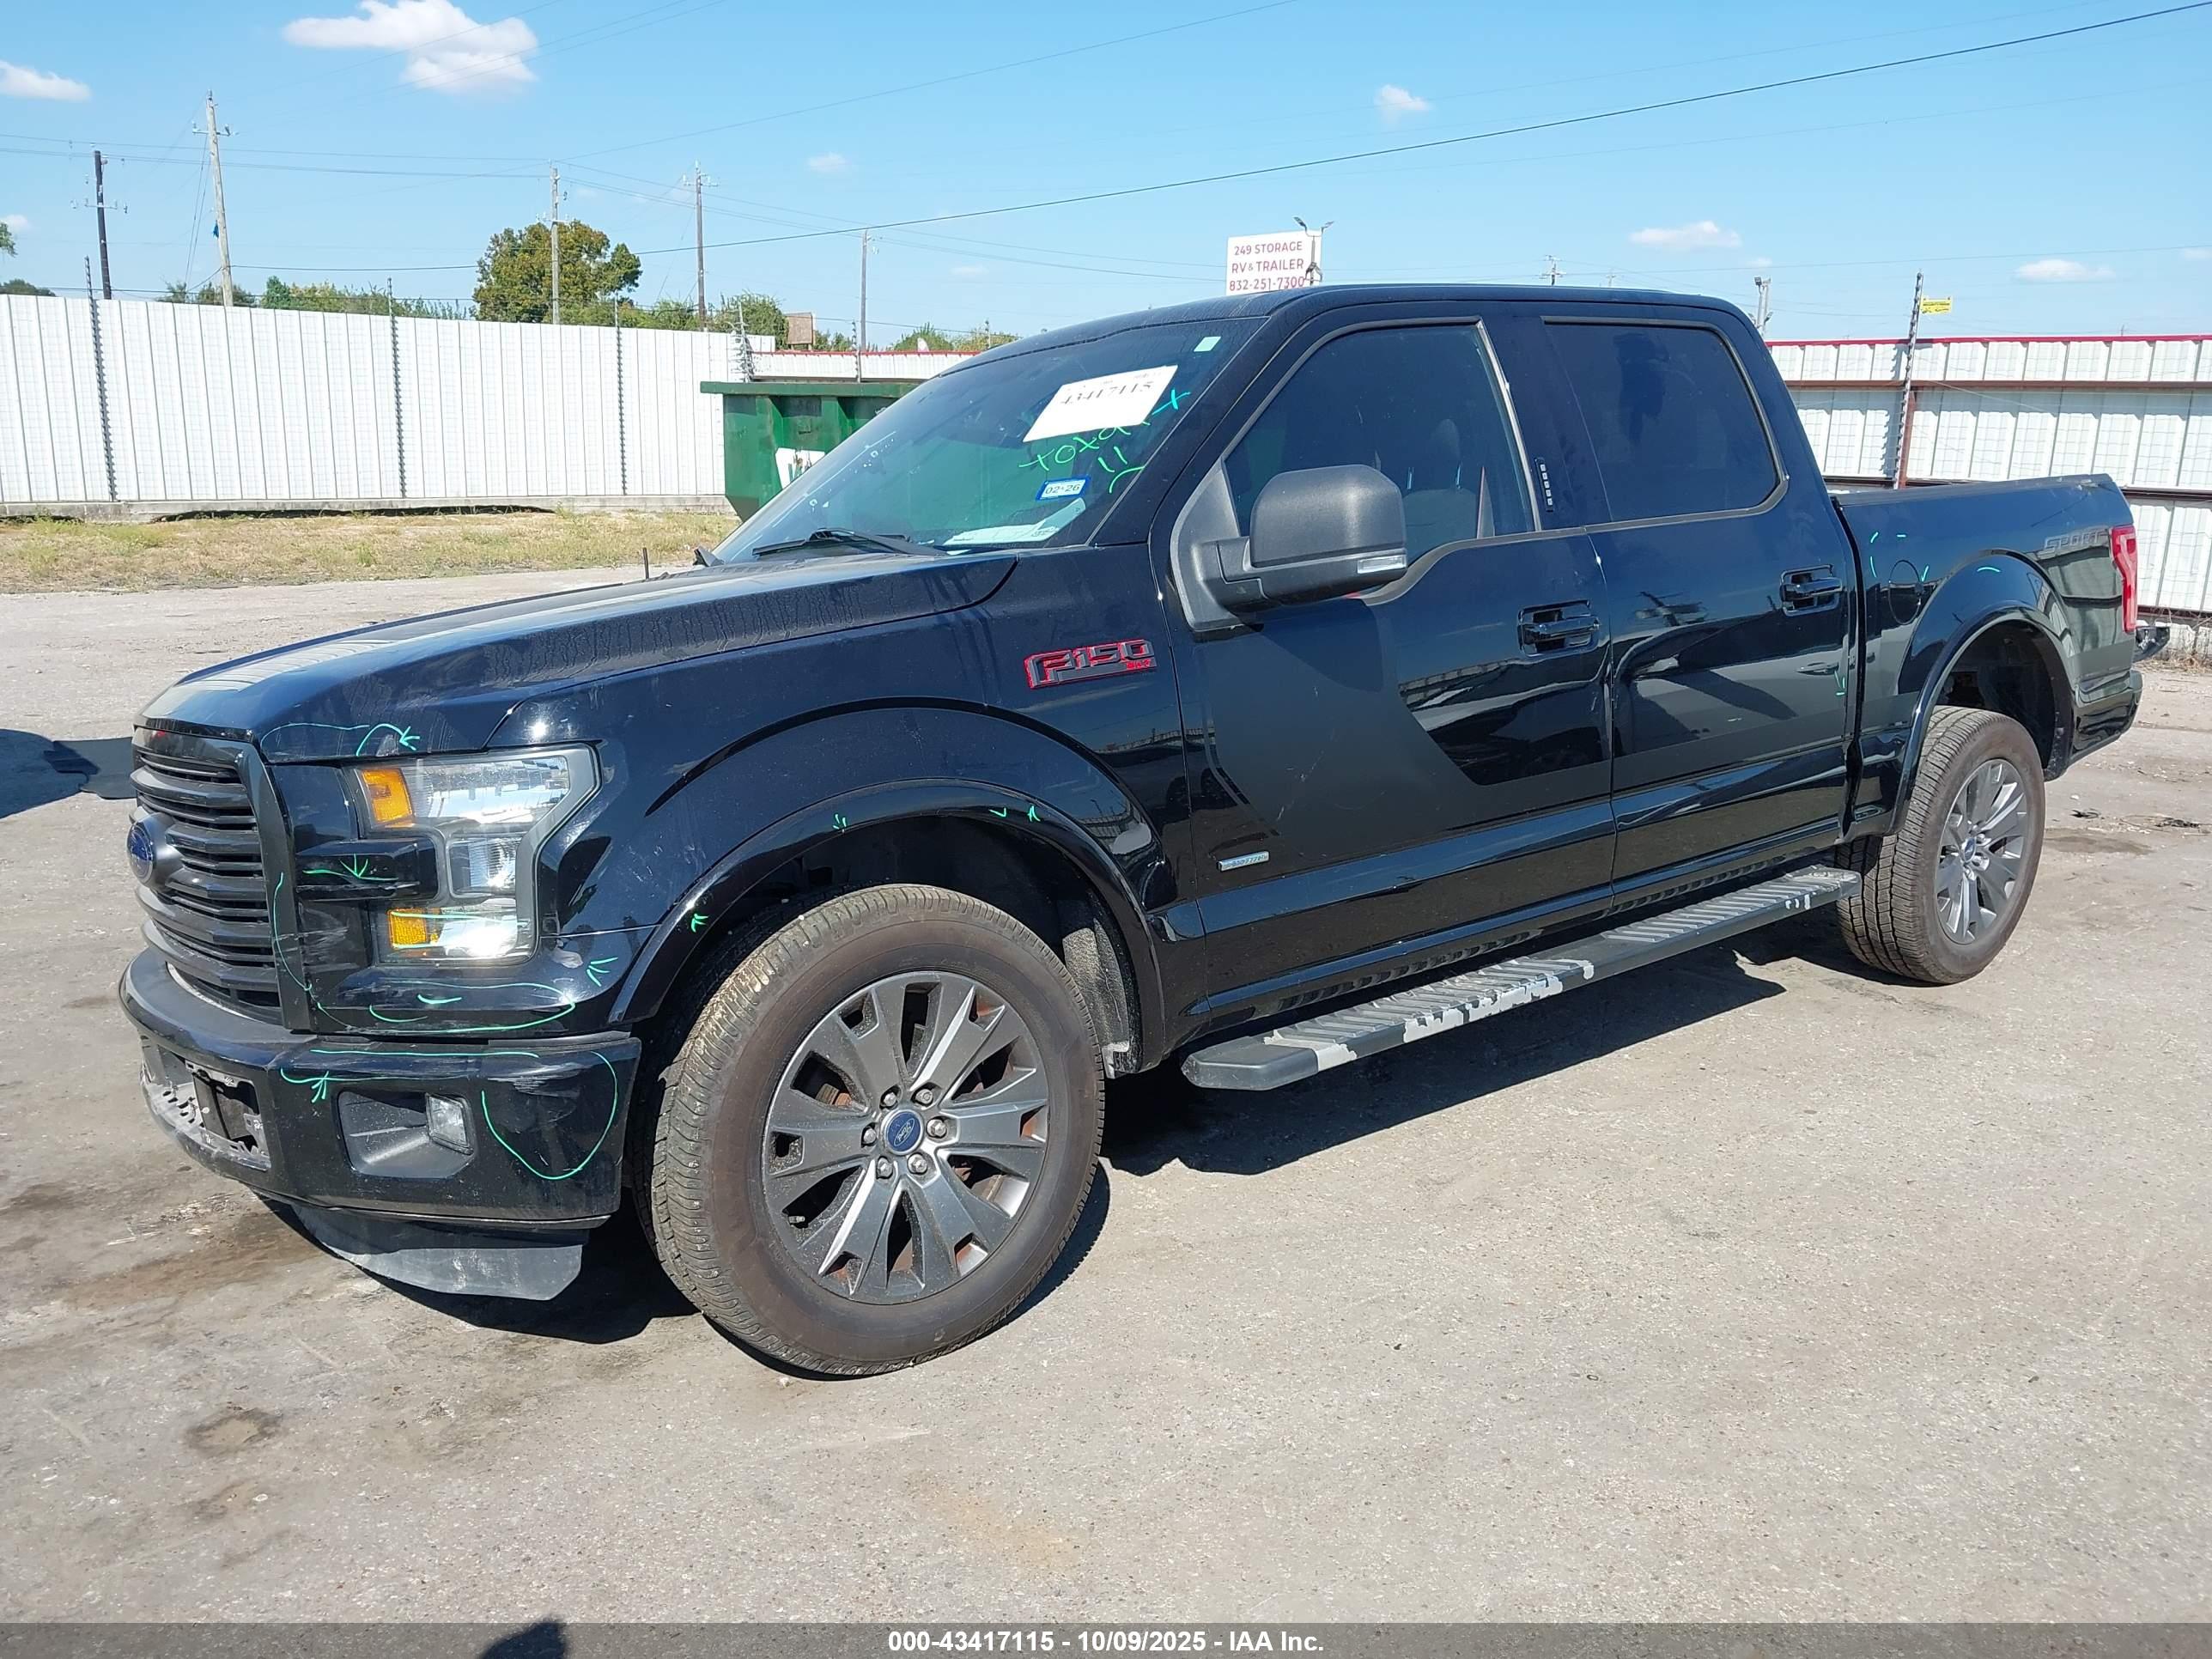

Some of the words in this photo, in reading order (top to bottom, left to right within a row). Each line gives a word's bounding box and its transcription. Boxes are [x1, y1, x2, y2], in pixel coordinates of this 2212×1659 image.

[1234, 246, 1252, 256] 249
[1255, 240, 1303, 254] STORAGE
[1229, 276, 1304, 291] 832-251-7300
